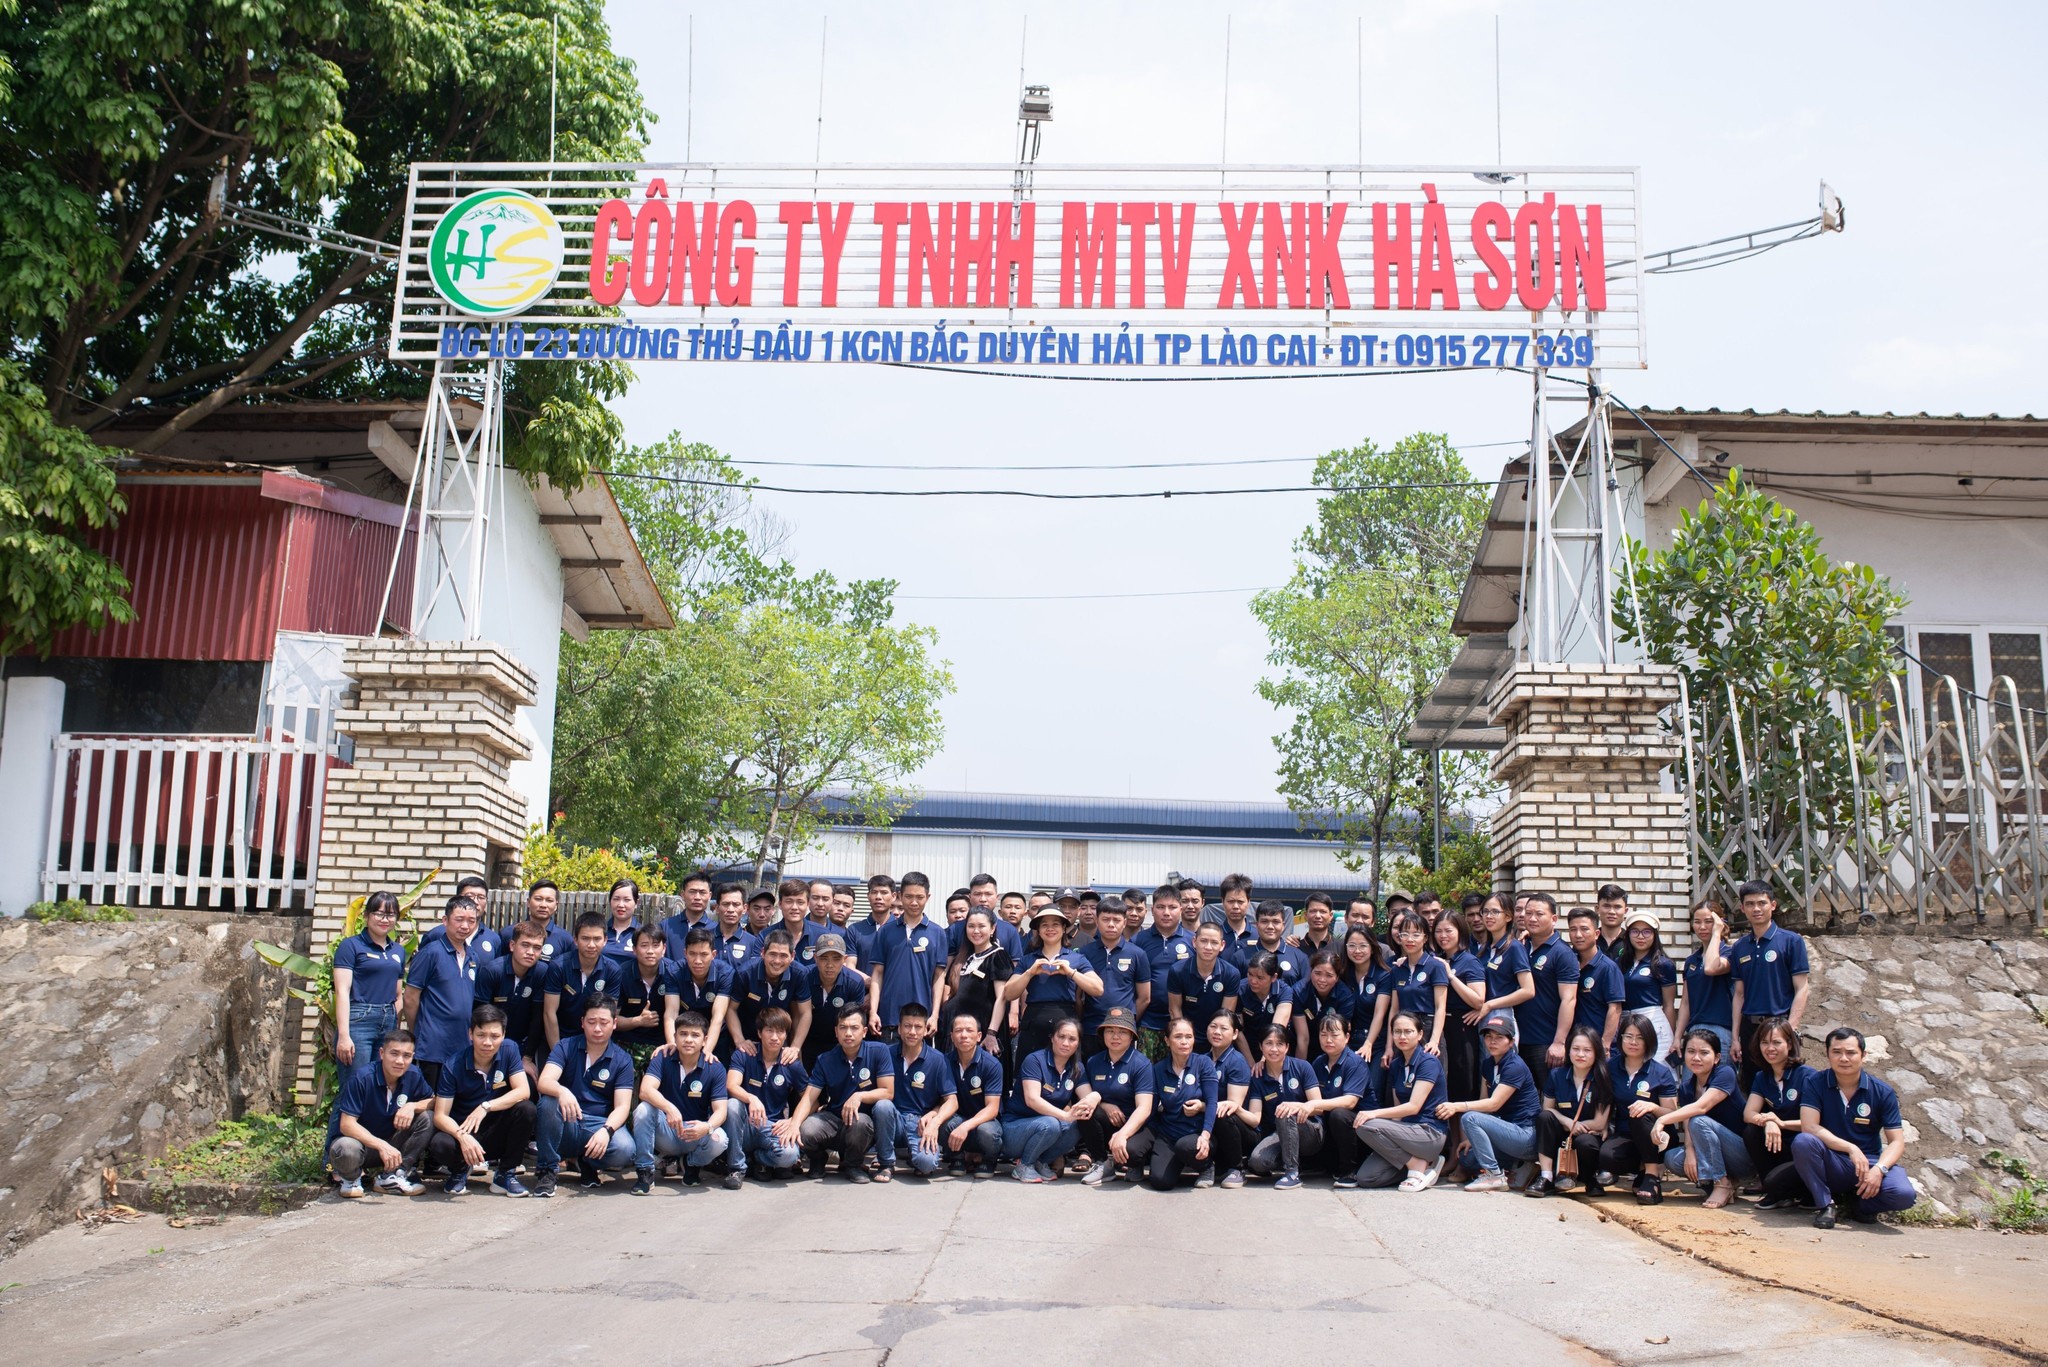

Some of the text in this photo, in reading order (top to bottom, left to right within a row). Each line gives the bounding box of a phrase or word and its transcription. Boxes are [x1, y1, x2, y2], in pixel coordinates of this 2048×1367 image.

[588, 178, 1608, 312] CÔNG TY TNHH MTV XNK HÀ SƠN
[440, 326, 481, 359] ĐC
[488, 320, 526, 359] LÔ
[532, 326, 571, 360] 23
[576, 318, 680, 360] ĐƯỜNG
[687, 317, 744, 361] THỦ
[752, 319, 813, 362] DẦU
[821, 330, 833, 362] 1
[840, 330, 904, 363] KCN
[909, 319, 969, 363] BẮC
[977, 325, 1080, 365] DUYÊN
[1092, 321, 1144, 365] HẢI
[1154, 333, 1192, 366] TP
[1201, 327, 1258, 366] LÀO
[1266, 333, 1317, 367] CAI
[1339, 334, 1389, 367] ĐT:
[1395, 333, 1467, 367] 0915
[1472, 334, 1530, 367] 277
[1536, 334, 1594, 368] 339
